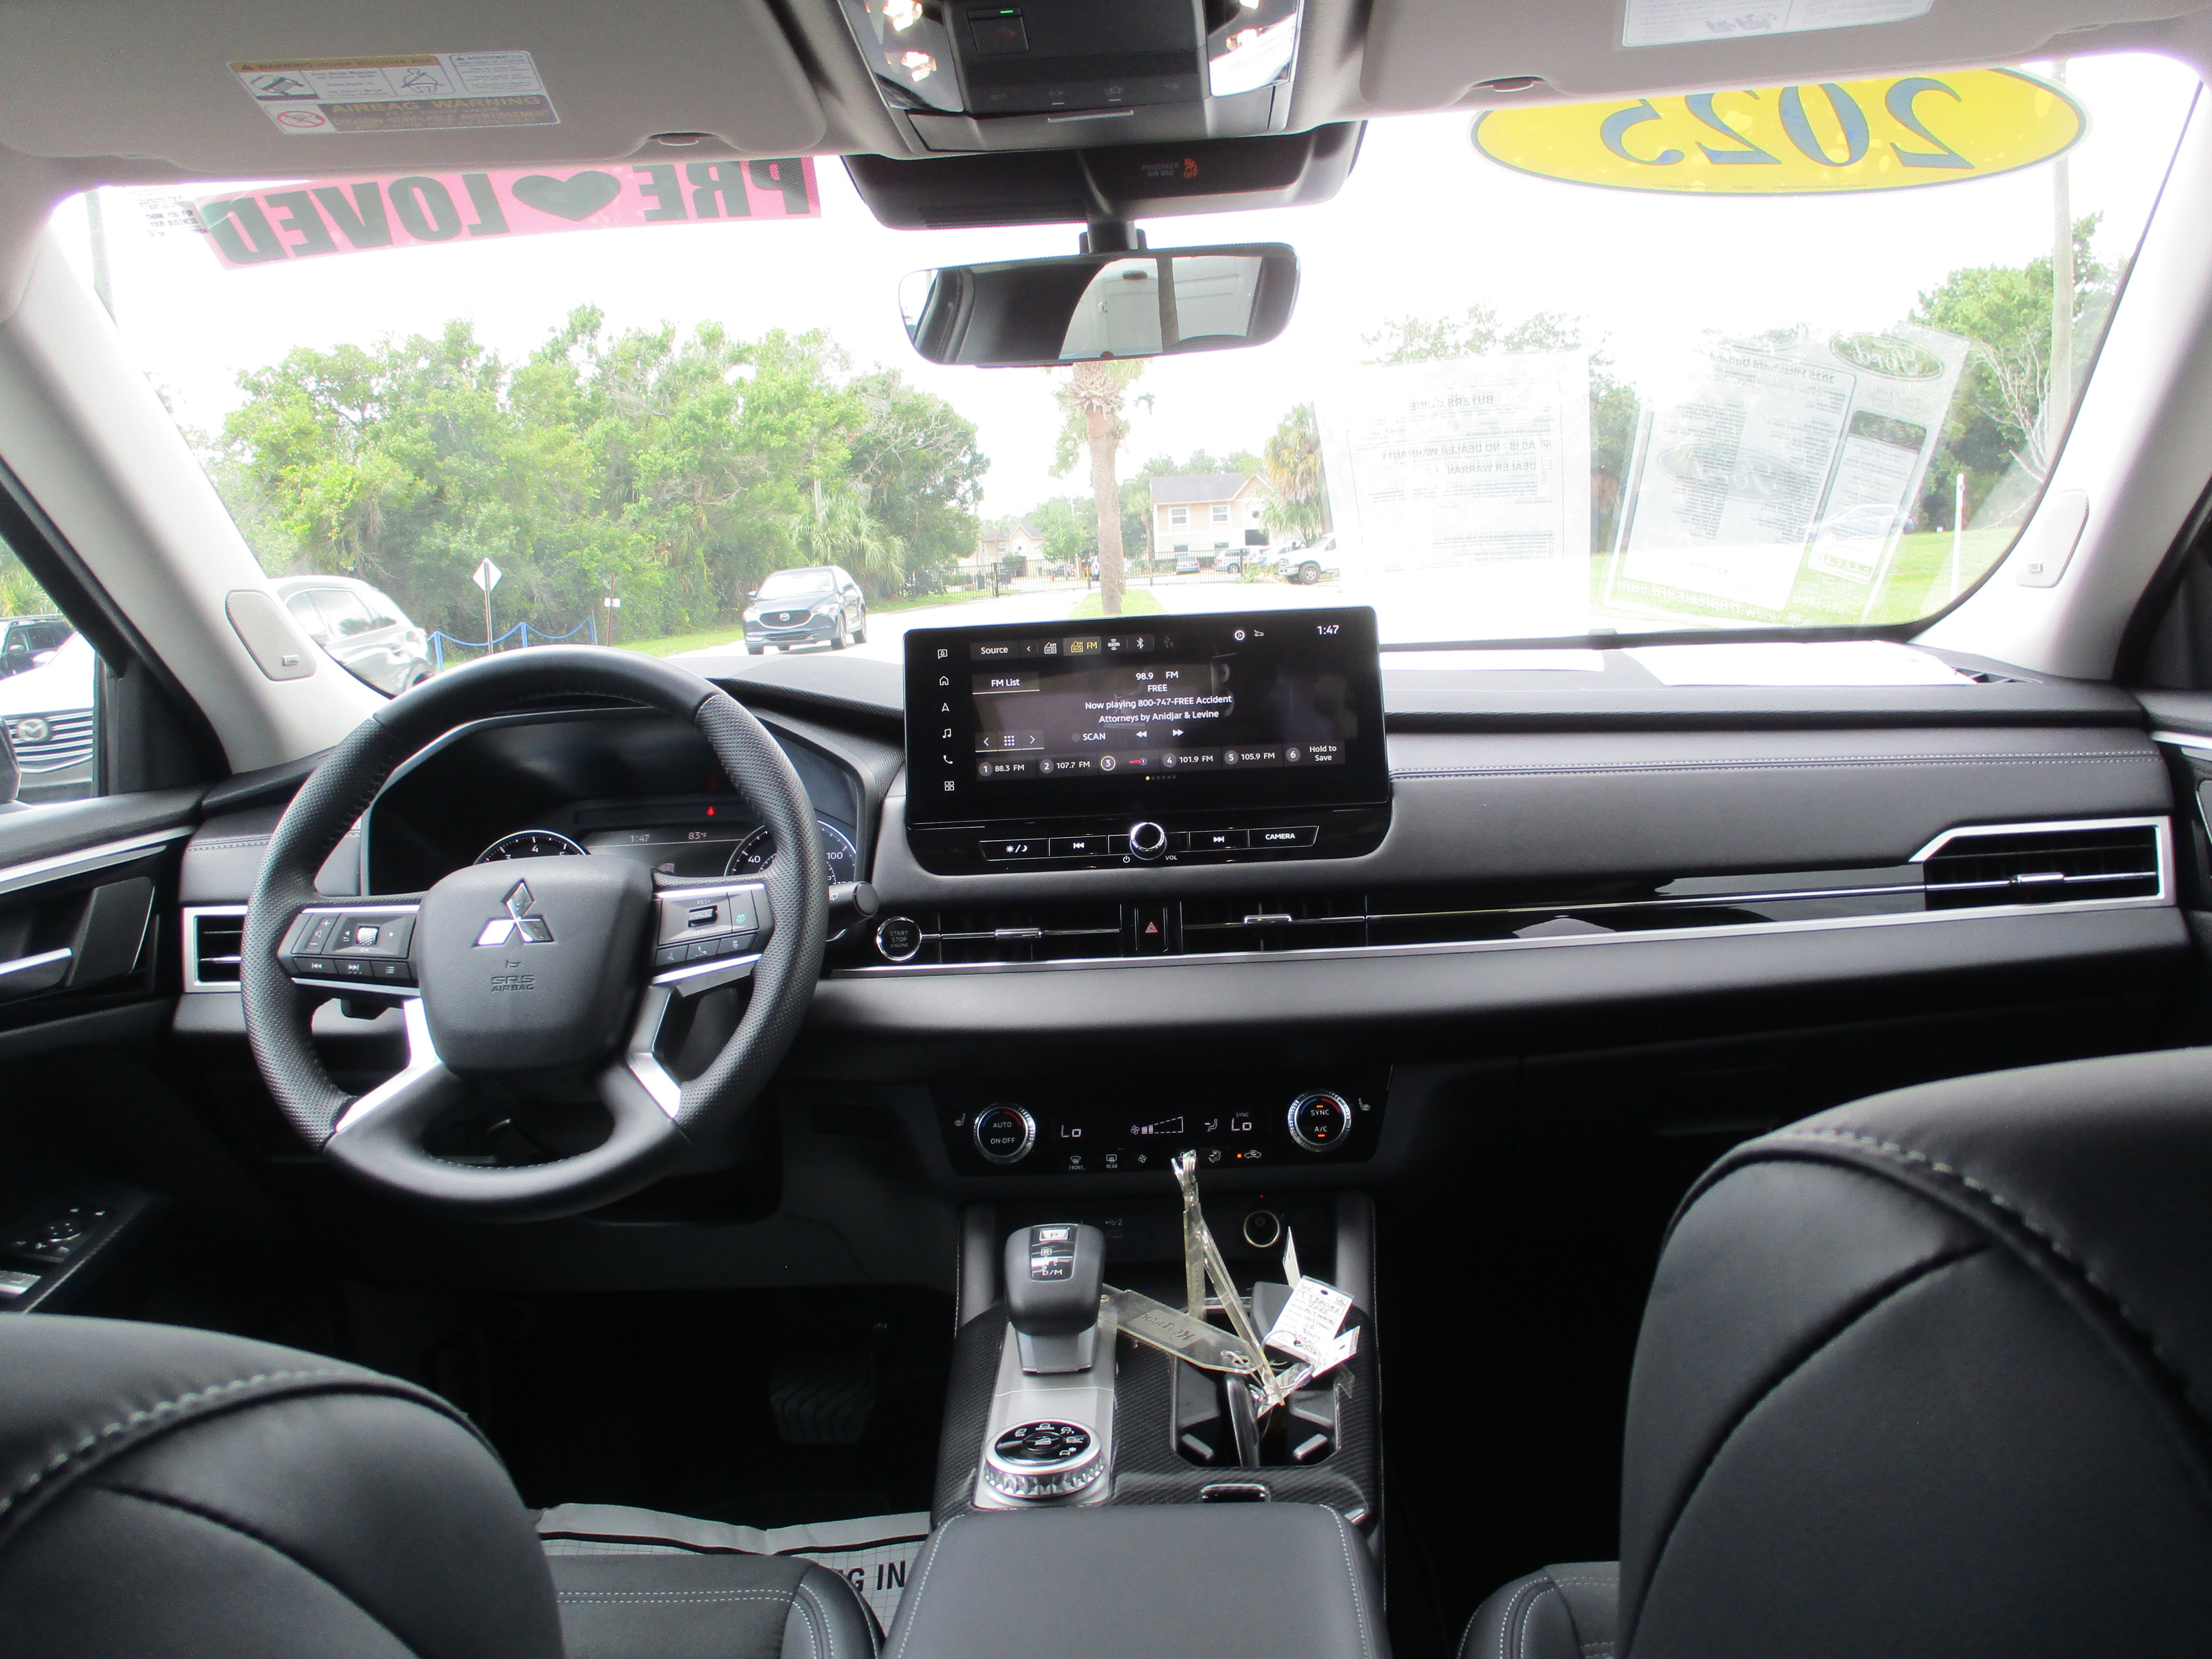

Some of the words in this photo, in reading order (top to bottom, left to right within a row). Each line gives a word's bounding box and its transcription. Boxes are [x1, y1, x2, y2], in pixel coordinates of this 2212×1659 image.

[1317, 625, 1339, 635] 1:47
[1136, 672, 1154, 681] 98.9
[1006, 678, 1020, 687] List
[1148, 684, 1167, 692] FREE
[1085, 702, 1104, 710] Now
[1106, 700, 1136, 710] playing
[1138, 697, 1194, 707] 800-747-FREE
[1196, 695, 1232, 705] Accident
[1099, 715, 1139, 723] Attorneys
[1152, 711, 1182, 721] Anidjar
[1193, 711, 1219, 719] Levine
[1083, 732, 1106, 741] SCAN
[532, 845, 538, 853] 4
[748, 855, 760, 863] 40
[826, 851, 843, 860] 100
[491, 975, 535, 984] SRS
[491, 984, 534, 992] AIRBAG
[1231, 1118, 1252, 1131] Lo
[1061, 1124, 1082, 1138] Lo
[877, 1560, 906, 1590] IN
